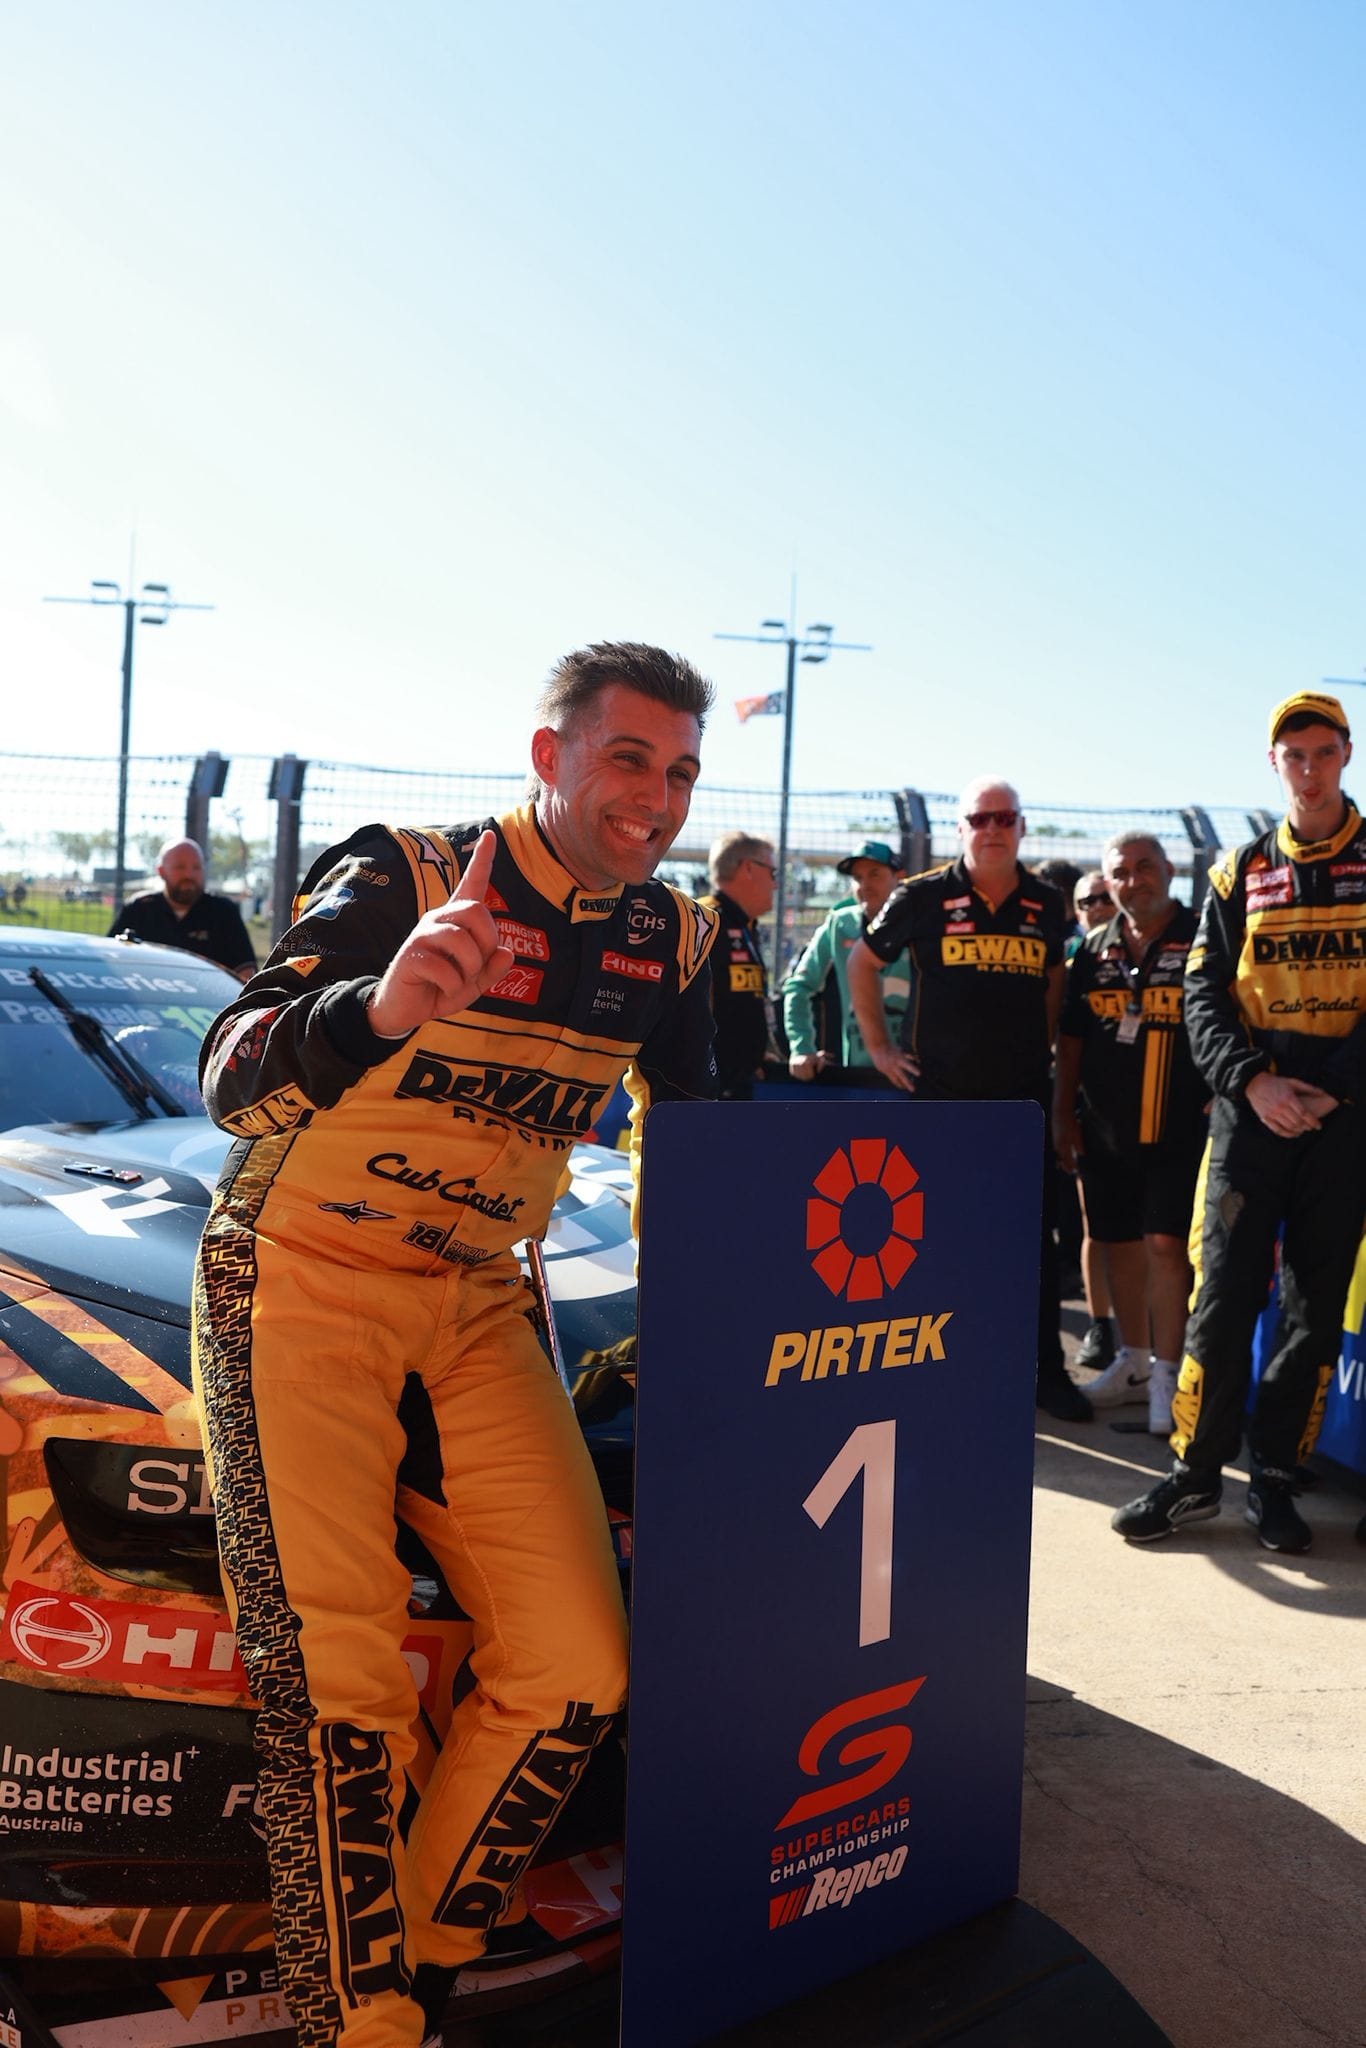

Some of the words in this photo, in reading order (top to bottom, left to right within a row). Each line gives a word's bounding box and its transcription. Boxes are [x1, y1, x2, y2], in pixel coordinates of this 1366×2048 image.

[496, 921, 541, 942] HUNGRY
[366, 1152, 443, 1192] Cub
[438, 1178, 527, 1224] Cadet
[402, 1221, 447, 1253] 18
[764, 1312, 954, 1387] PIRTEK
[802, 1419, 897, 1648] 1
[1, 1744, 183, 1783] Industrial
[0, 1780, 173, 1817] Batteries
[0, 1814, 84, 1834] Australia
[770, 1797, 911, 1866] SUPERCARS
[769, 1818, 911, 1884] CHAMPIONSHIP
[801, 1845, 909, 1917] Repco
